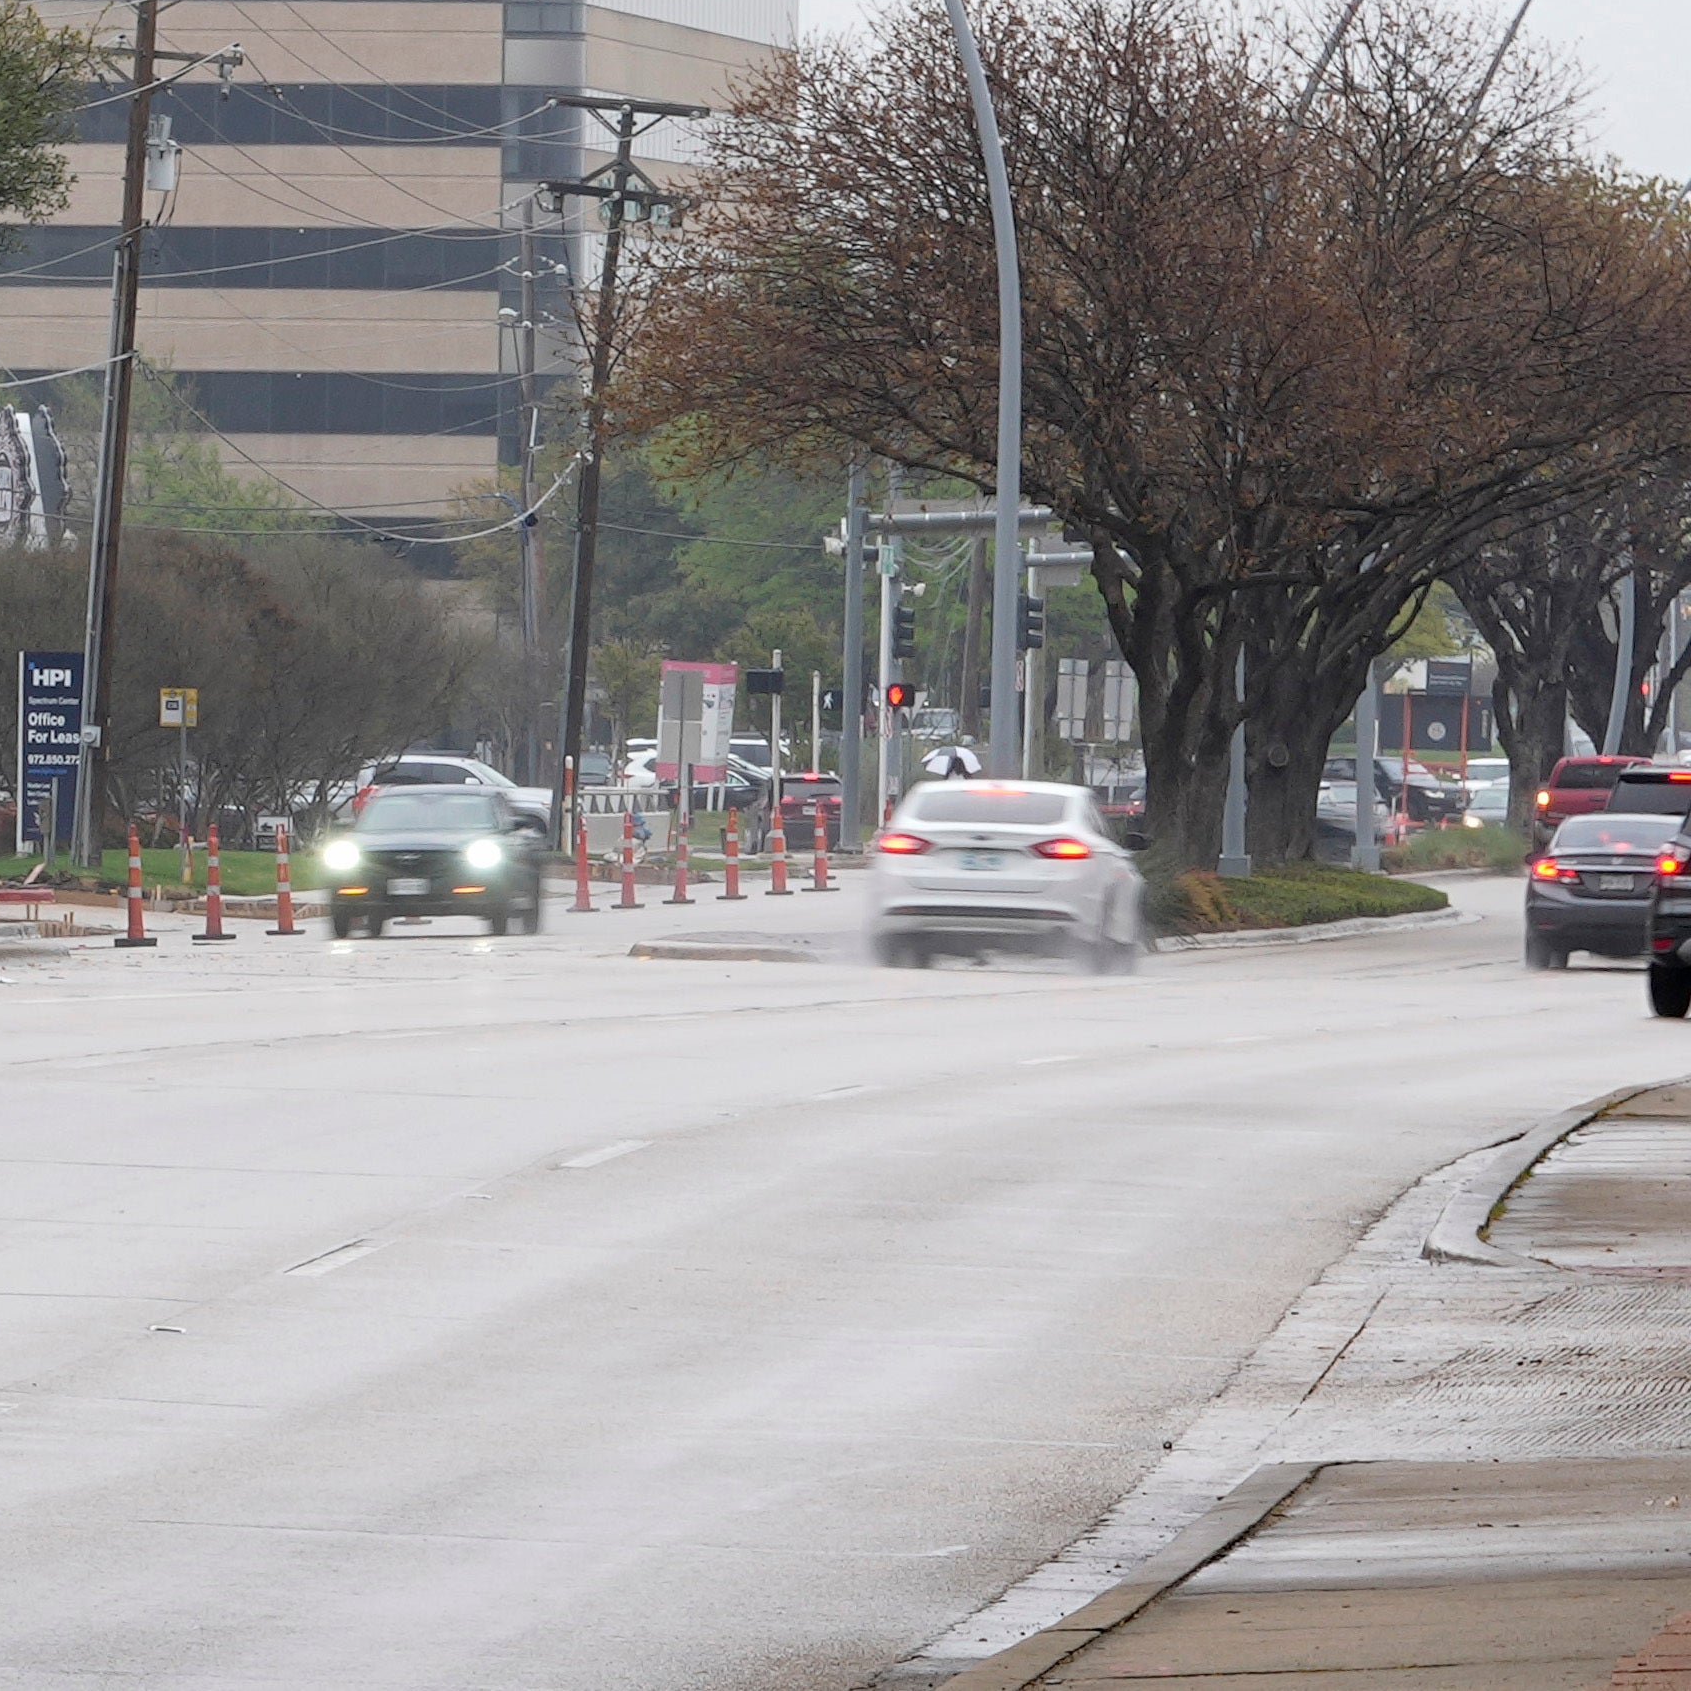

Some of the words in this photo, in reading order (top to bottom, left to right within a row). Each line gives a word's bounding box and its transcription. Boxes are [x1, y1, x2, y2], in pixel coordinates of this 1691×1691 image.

[32, 668, 72, 687] HPI
[27, 712, 66, 727] Office
[27, 729, 49, 744] For
[50, 729, 80, 744] Leas
